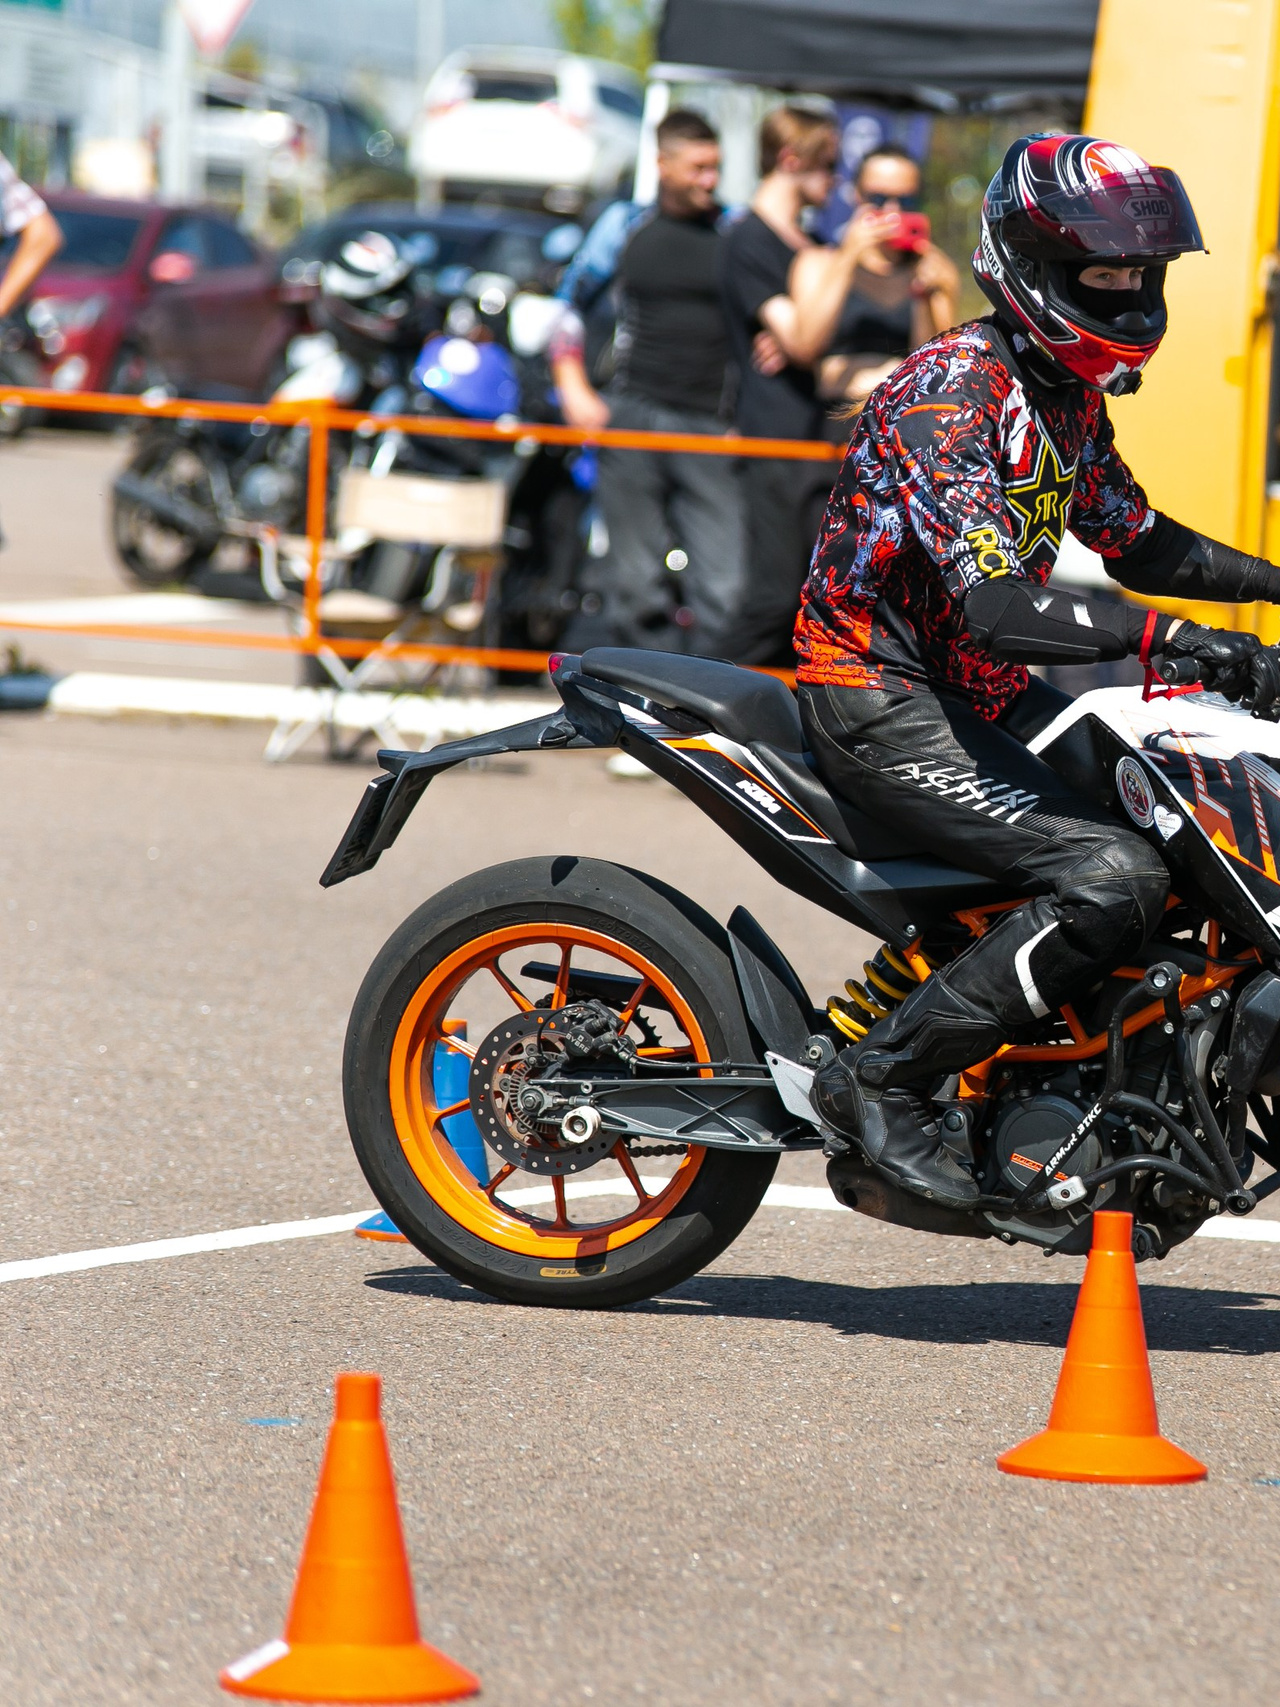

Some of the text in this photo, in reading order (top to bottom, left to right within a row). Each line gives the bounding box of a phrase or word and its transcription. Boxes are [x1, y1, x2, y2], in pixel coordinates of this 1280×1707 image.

[1131, 200, 1171, 217] SHOEI
[982, 235, 1001, 276] SHOEI
[735, 779, 782, 815] KTM
[565, 1031, 590, 1054] BYBRE
